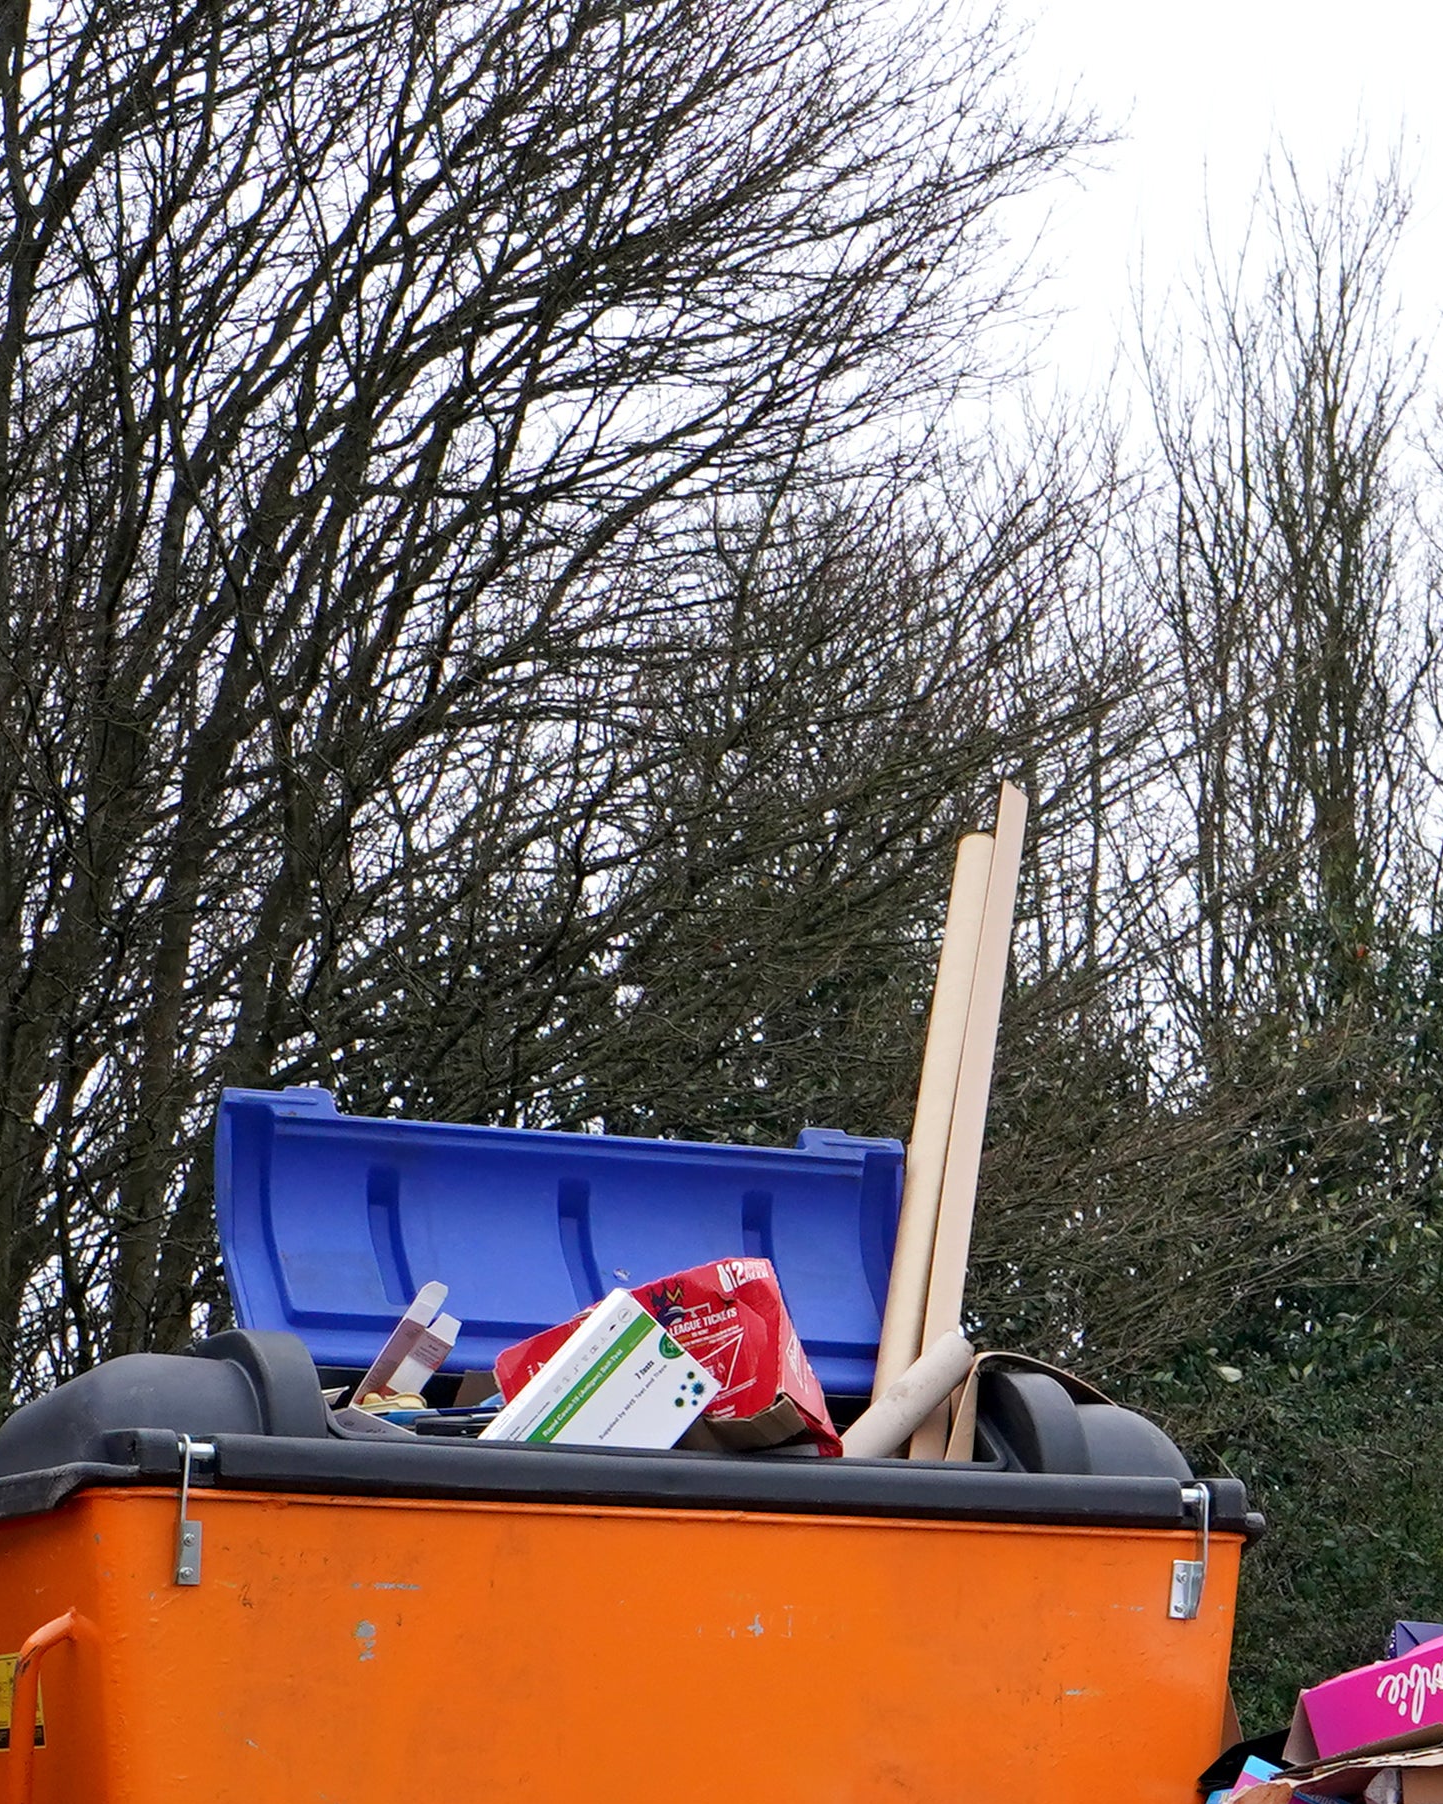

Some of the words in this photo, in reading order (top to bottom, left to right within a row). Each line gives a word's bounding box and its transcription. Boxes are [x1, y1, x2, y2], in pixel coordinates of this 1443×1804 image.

[669, 1319, 702, 1336] LEAGUE
[704, 1307, 738, 1326] TICKETS
[634, 1372, 643, 1381] 7
[637, 1358, 656, 1377] tests
[597, 1416, 621, 1441] Supplied
[617, 1409, 627, 1420] by
[634, 1386, 647, 1400] Test
[643, 1376, 656, 1389] and
[541, 1418, 561, 1439] Rapid
